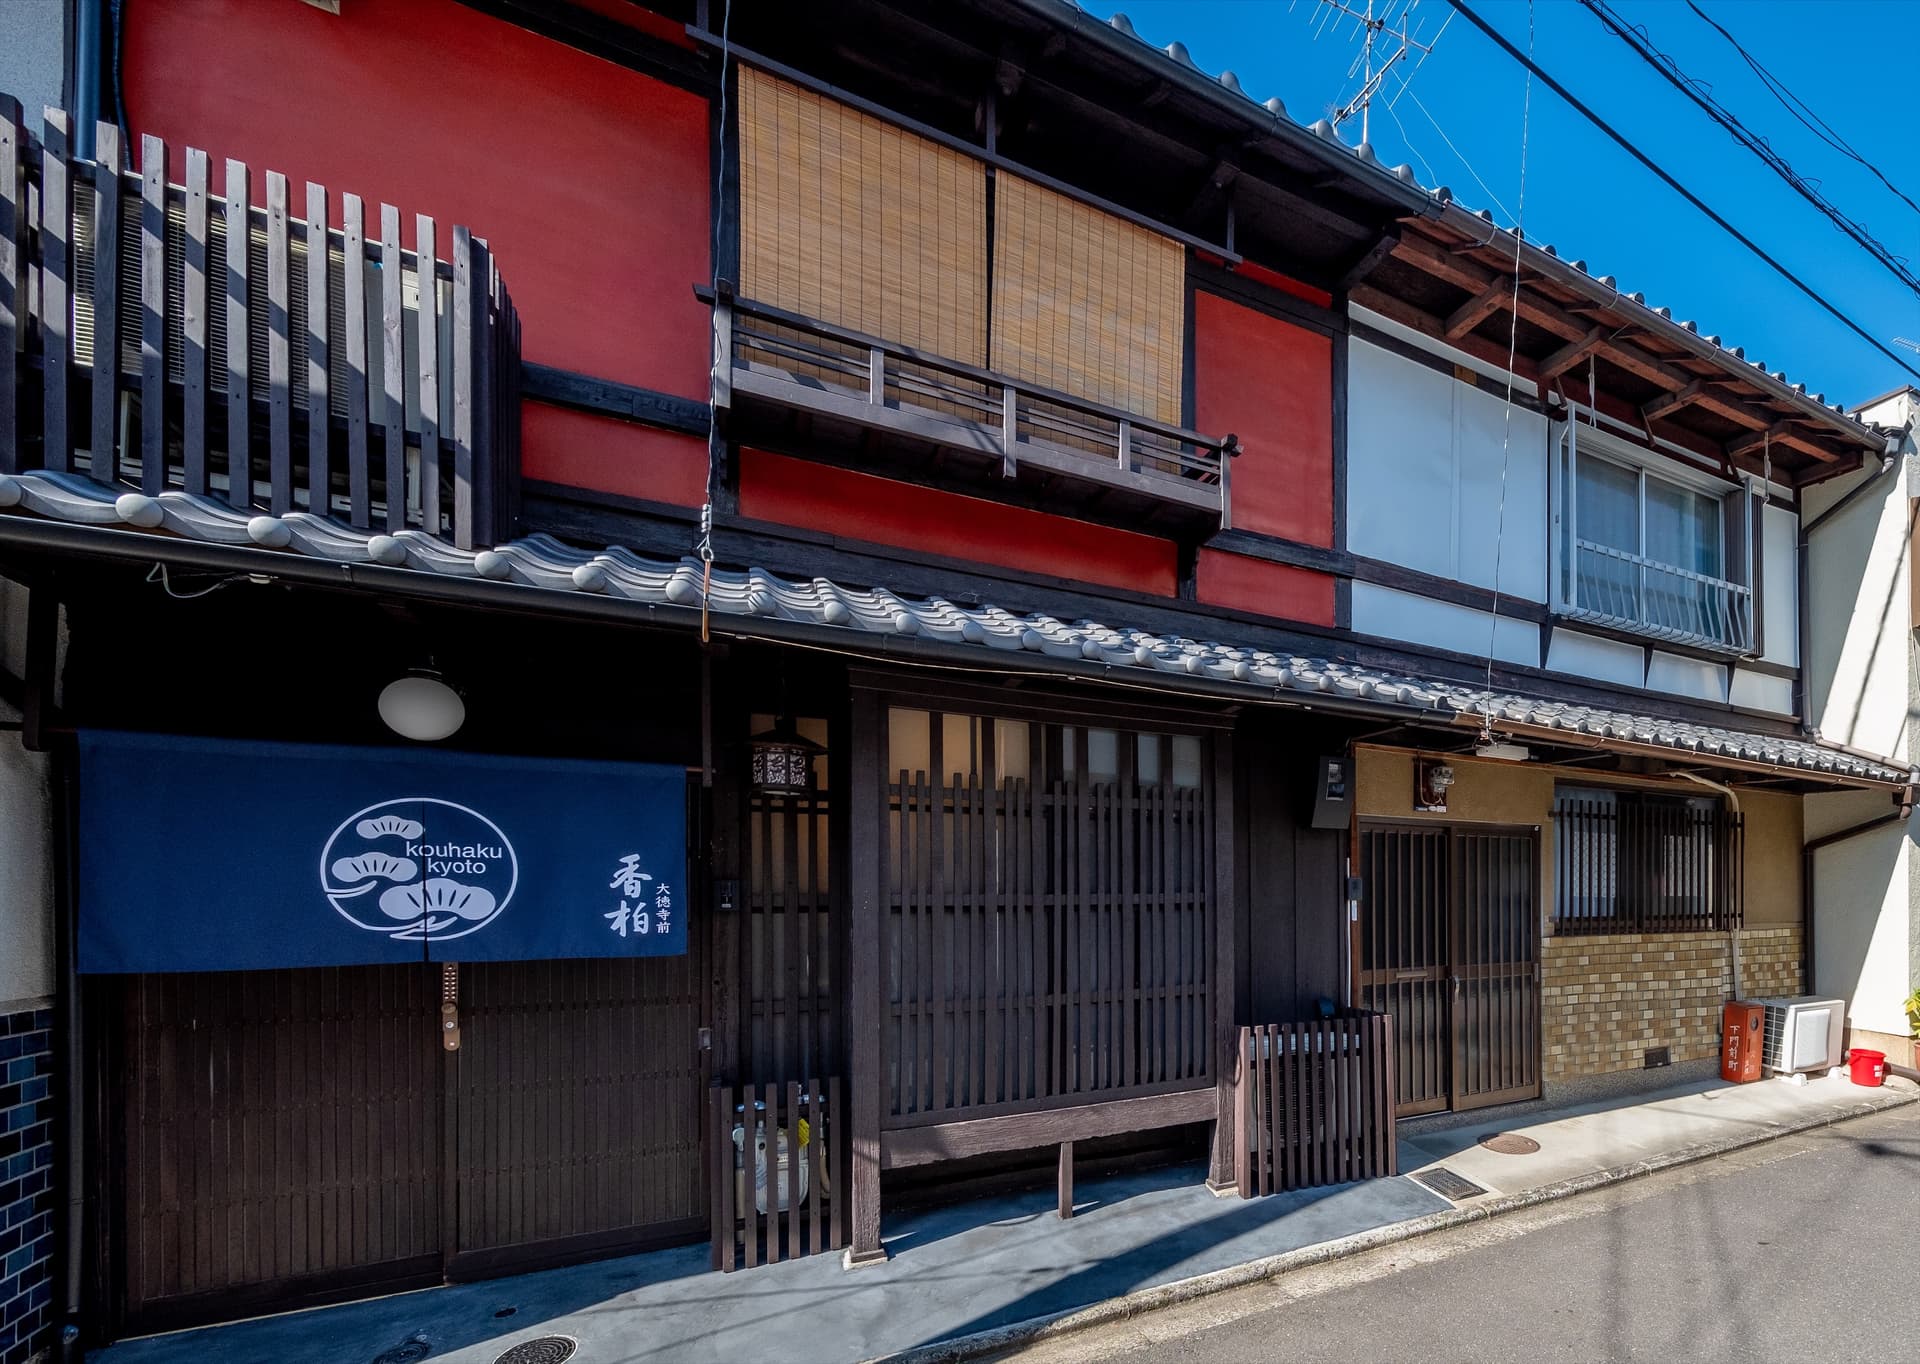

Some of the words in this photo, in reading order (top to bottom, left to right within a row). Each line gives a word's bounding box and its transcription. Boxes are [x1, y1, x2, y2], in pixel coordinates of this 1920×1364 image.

[405, 841, 503, 858] kouhaku
[427, 857, 487, 877] kyoto
[603, 853, 653, 938] 香柏
[655, 882, 671, 934] 大徳寺前
[1728, 1025, 1740, 1072] 下門前町
